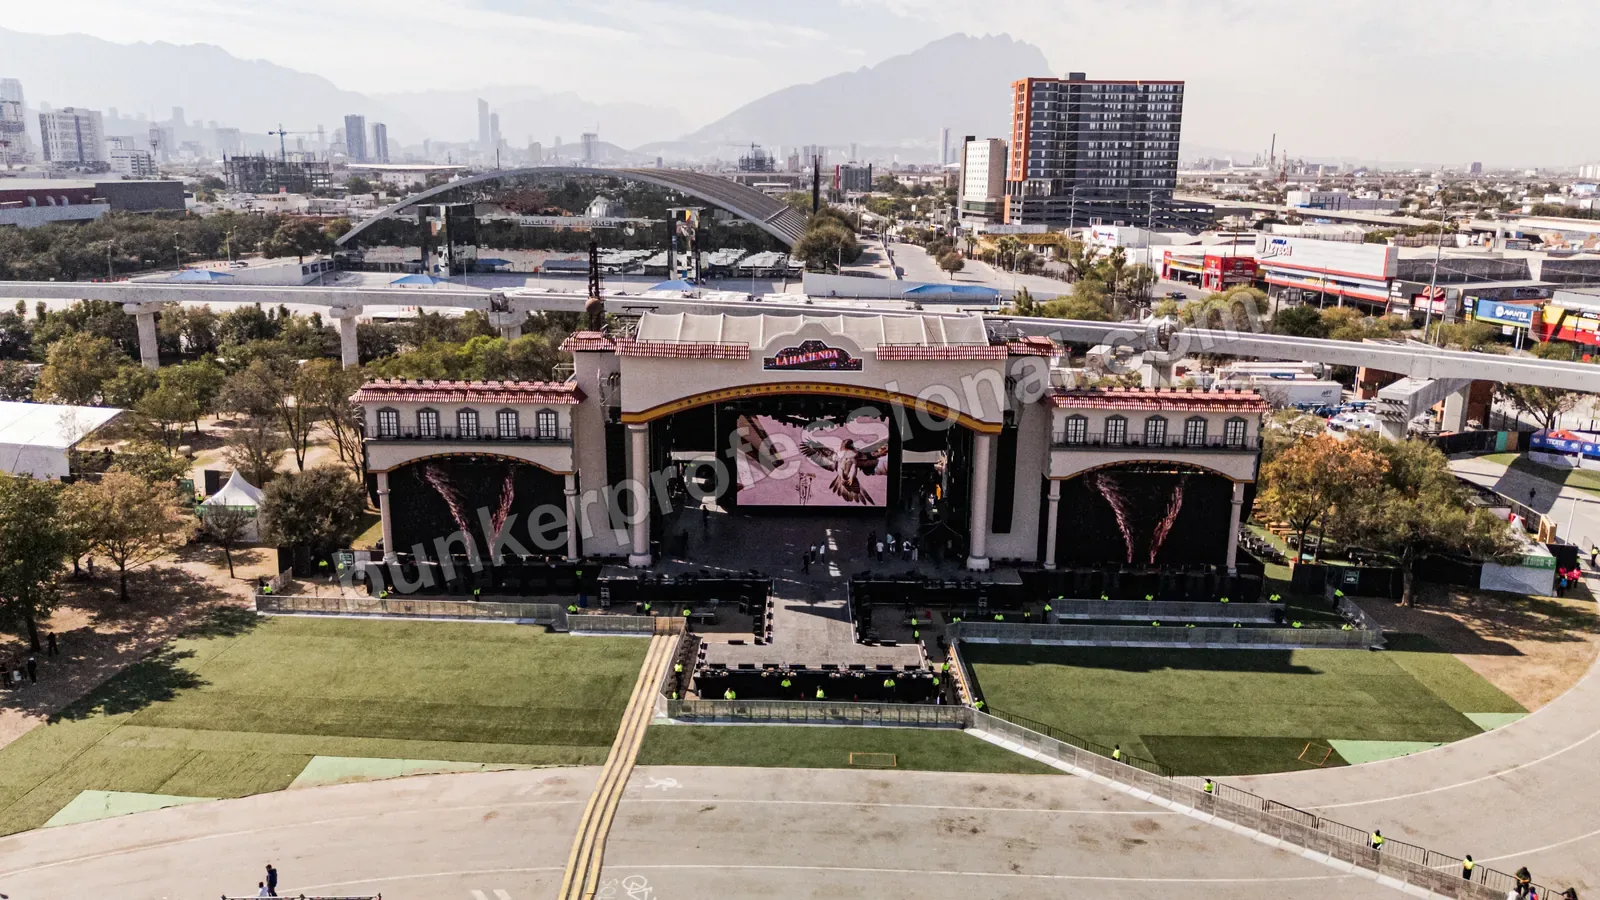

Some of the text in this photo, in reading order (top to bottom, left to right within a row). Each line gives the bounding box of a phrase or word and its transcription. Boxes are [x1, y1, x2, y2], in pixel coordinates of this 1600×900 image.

[520, 218, 554, 226] ARENA
[776, 349, 838, 366] LA HACIENDA
[1545, 438, 1567, 447] TECATE
